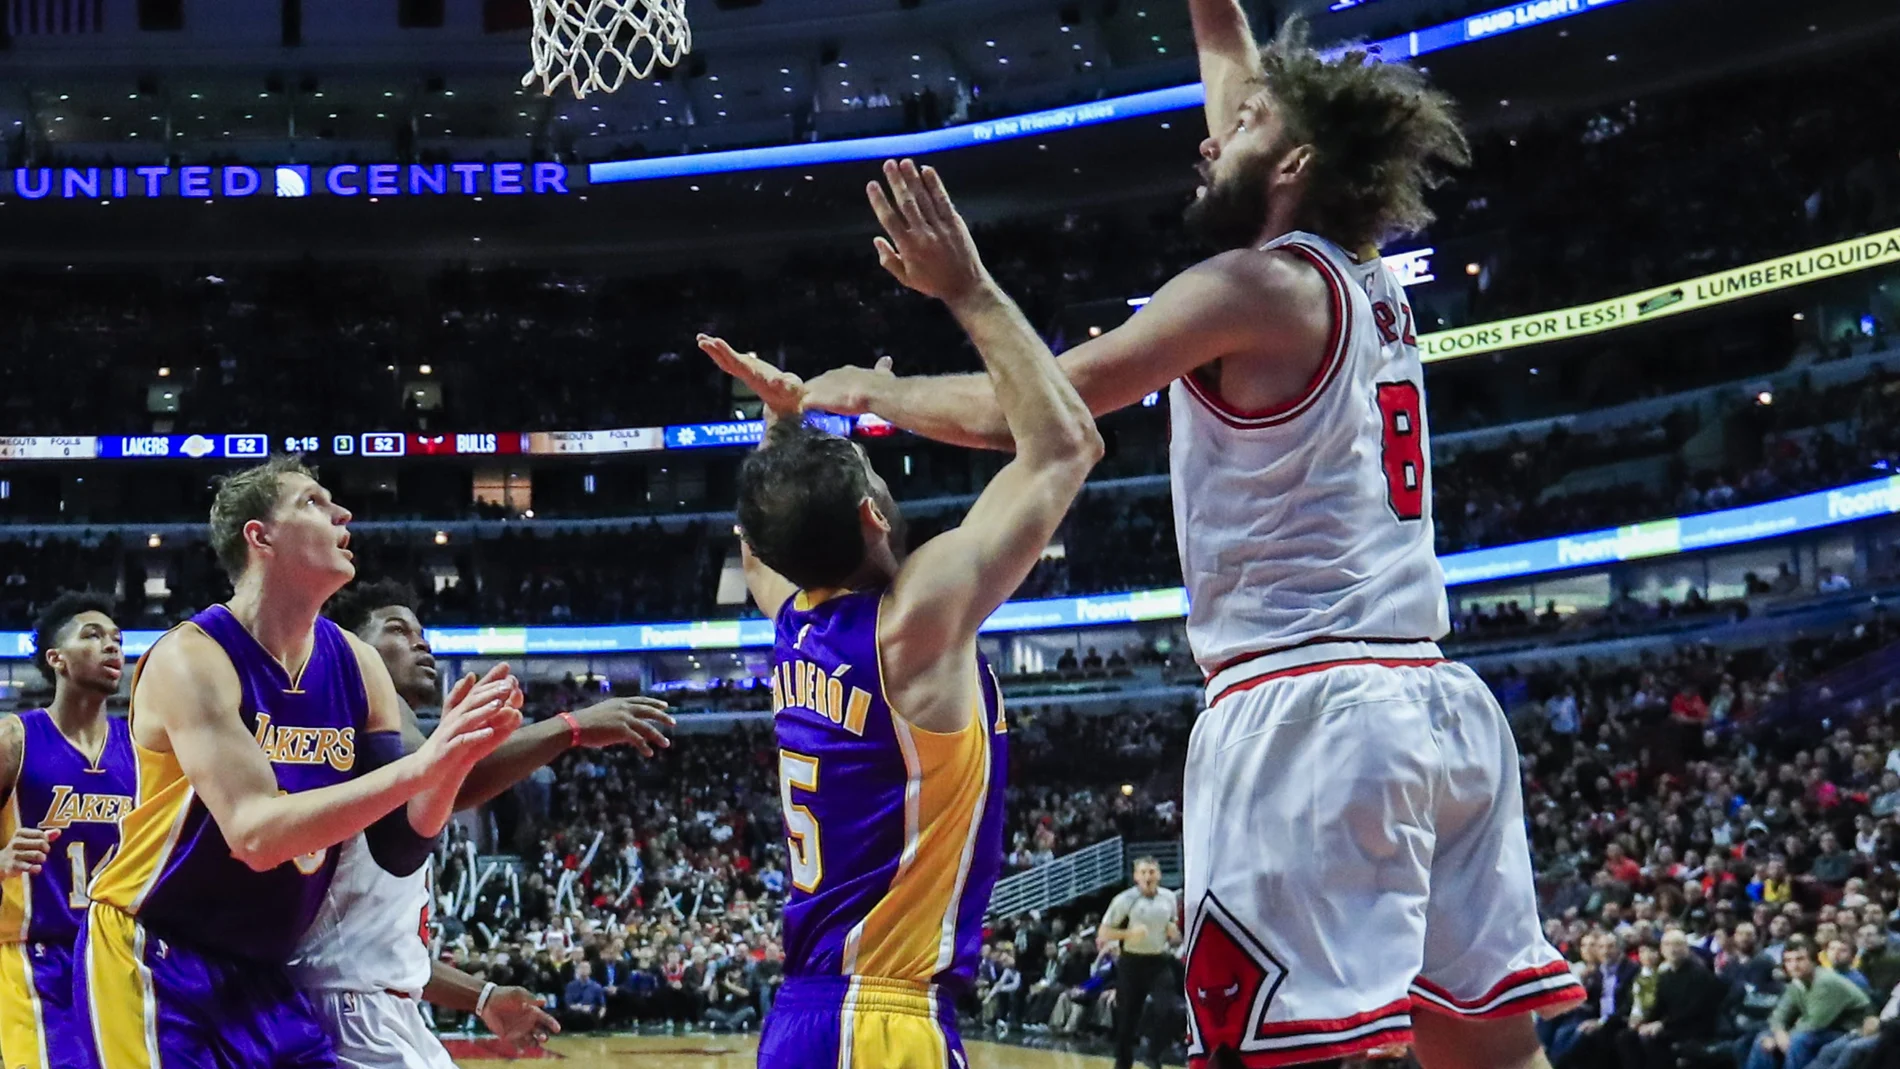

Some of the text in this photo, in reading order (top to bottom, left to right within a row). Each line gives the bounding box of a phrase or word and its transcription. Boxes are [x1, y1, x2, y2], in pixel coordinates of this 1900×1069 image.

[1468, 11, 1515, 37] BUD
[995, 121, 1018, 136] the
[1020, 111, 1075, 132] friendly
[1077, 104, 1115, 121] skies
[14, 162, 570, 198] UNITED CENTER
[1697, 236, 1900, 300] LUMBERLIQUIDA
[1511, 318, 1557, 340] FOR
[1566, 303, 1625, 330] LESS!
[51, 437, 81, 446] FOULS
[701, 421, 764, 437] VIDANTA
[122, 437, 169, 456] LAKERS
[236, 438, 256, 453] 52
[284, 436, 319, 452] 9:15
[339, 437, 348, 449] 3
[373, 437, 393, 452] 52
[456, 433, 497, 453] BULLS
[1376, 379, 1424, 522] 8
[773, 659, 872, 736] ALDERÓN
[37, 785, 133, 829] LAKER
[779, 748, 823, 894] 5
